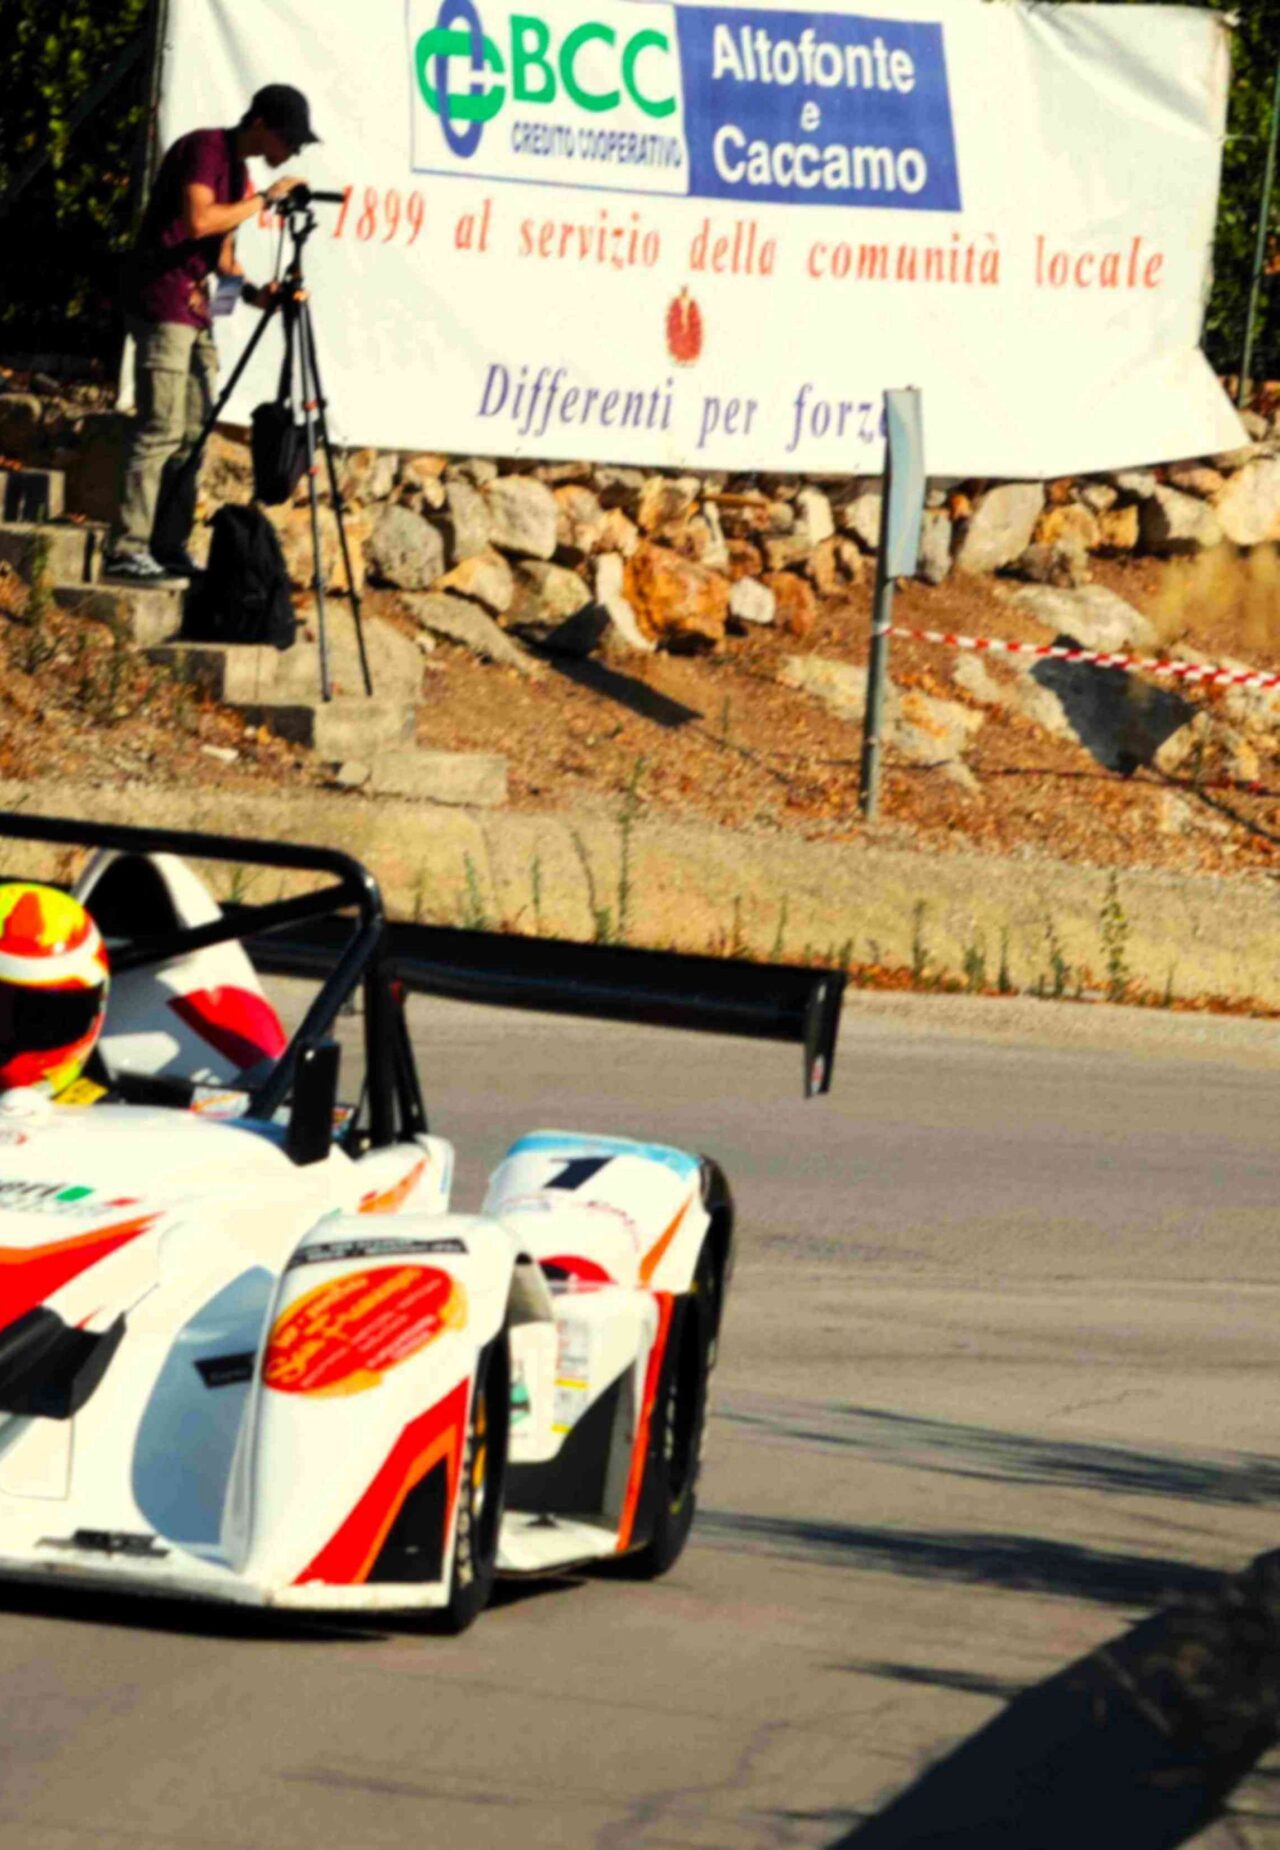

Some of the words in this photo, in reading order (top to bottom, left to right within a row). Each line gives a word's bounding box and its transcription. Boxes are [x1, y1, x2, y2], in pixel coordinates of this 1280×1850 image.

[510, 14, 677, 119] BCC
[712, 23, 916, 94] Altofonte
[511, 120, 574, 158] CREDITO
[578, 127, 682, 169] COOPERATIVO
[800, 101, 821, 131] e
[713, 124, 928, 194] Caccamo
[331, 184, 424, 245] 1899
[453, 198, 490, 253] al
[519, 208, 661, 271] servizio
[689, 217, 777, 276] della
[807, 231, 1000, 286] comunità
[1035, 233, 1164, 289] locale
[477, 363, 674, 437] Differenti
[696, 392, 758, 450] per
